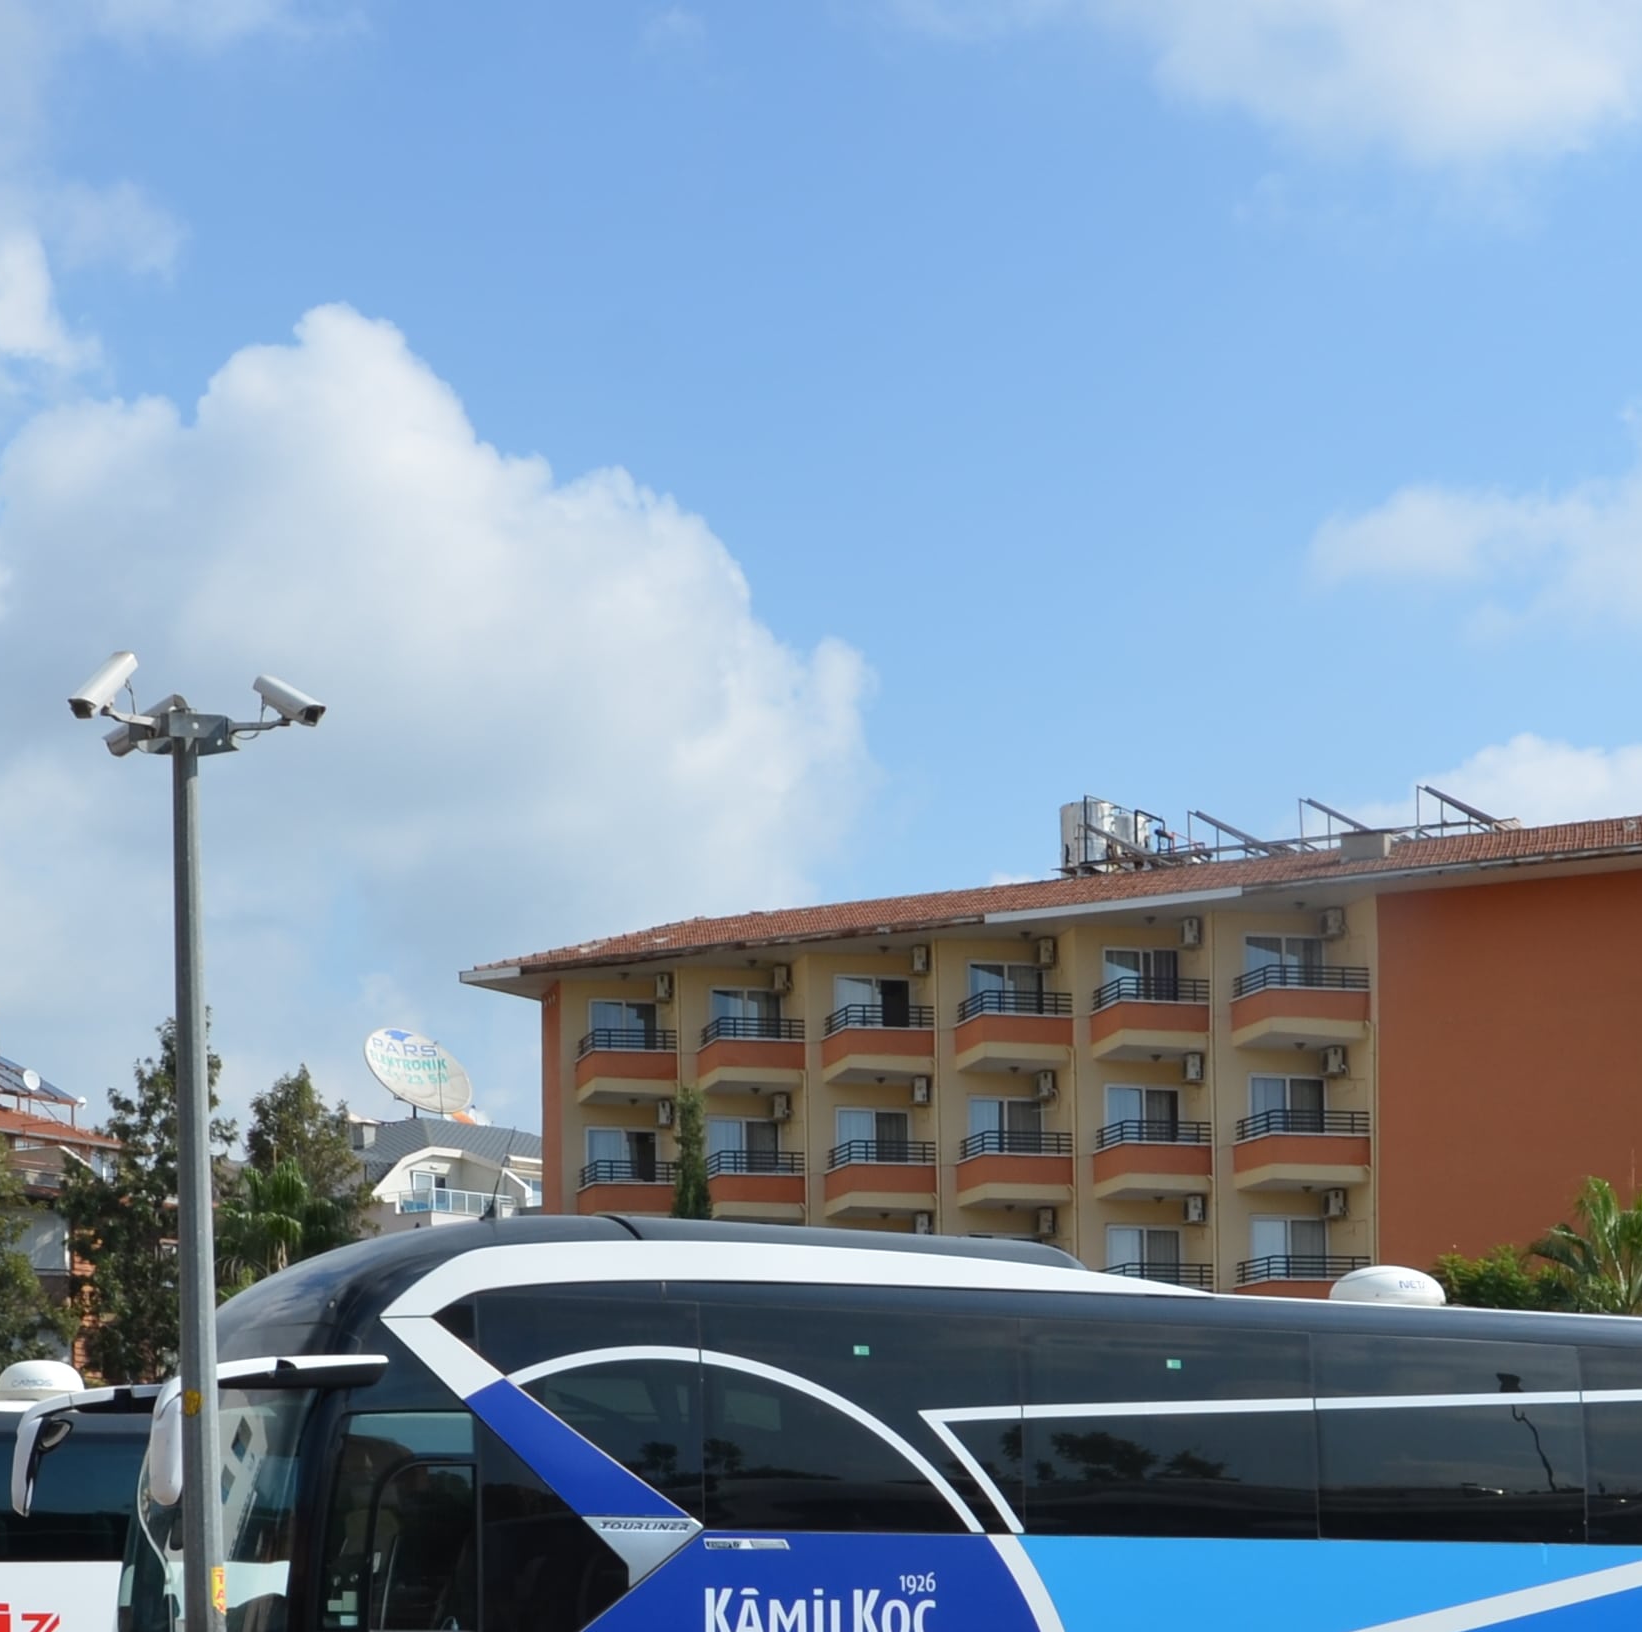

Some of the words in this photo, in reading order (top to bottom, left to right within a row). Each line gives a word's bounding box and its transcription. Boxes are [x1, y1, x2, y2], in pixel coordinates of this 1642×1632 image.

[372, 1037, 438, 1057] PARS
[600, 1521, 691, 1532] TOURLINER
[899, 1572, 936, 1595] 1926
